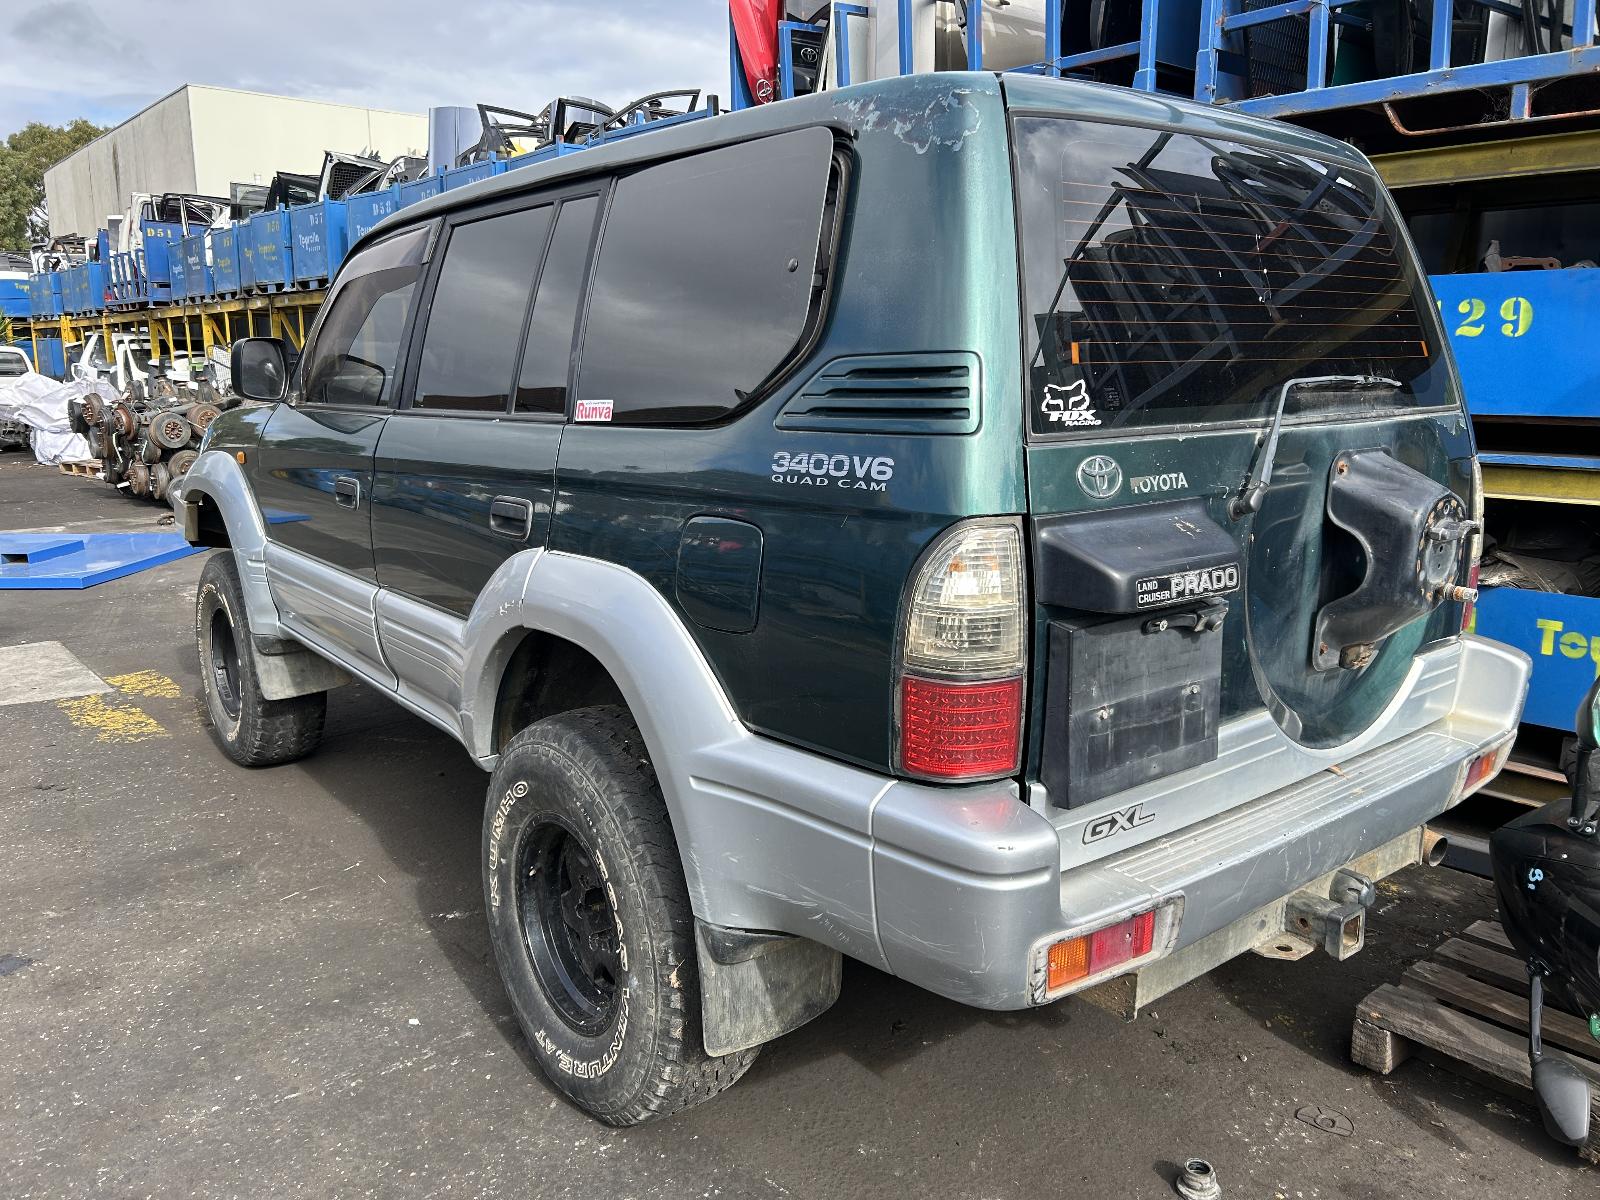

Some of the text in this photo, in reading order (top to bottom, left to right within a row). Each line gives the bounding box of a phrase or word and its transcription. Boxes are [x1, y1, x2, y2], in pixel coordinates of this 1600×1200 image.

[1437, 297, 1533, 337] 29
[577, 402, 611, 420] Runva
[1043, 409, 1097, 422] FOX
[1065, 419, 1102, 427] RACING
[771, 474, 887, 492] QUAD CAM
[1137, 580, 1158, 593] LAND
[1170, 567, 1238, 599] PRADO
[1138, 590, 1171, 604] CRUISER
[1082, 803, 1156, 845] GXL
[489, 781, 529, 907] KUMHO
